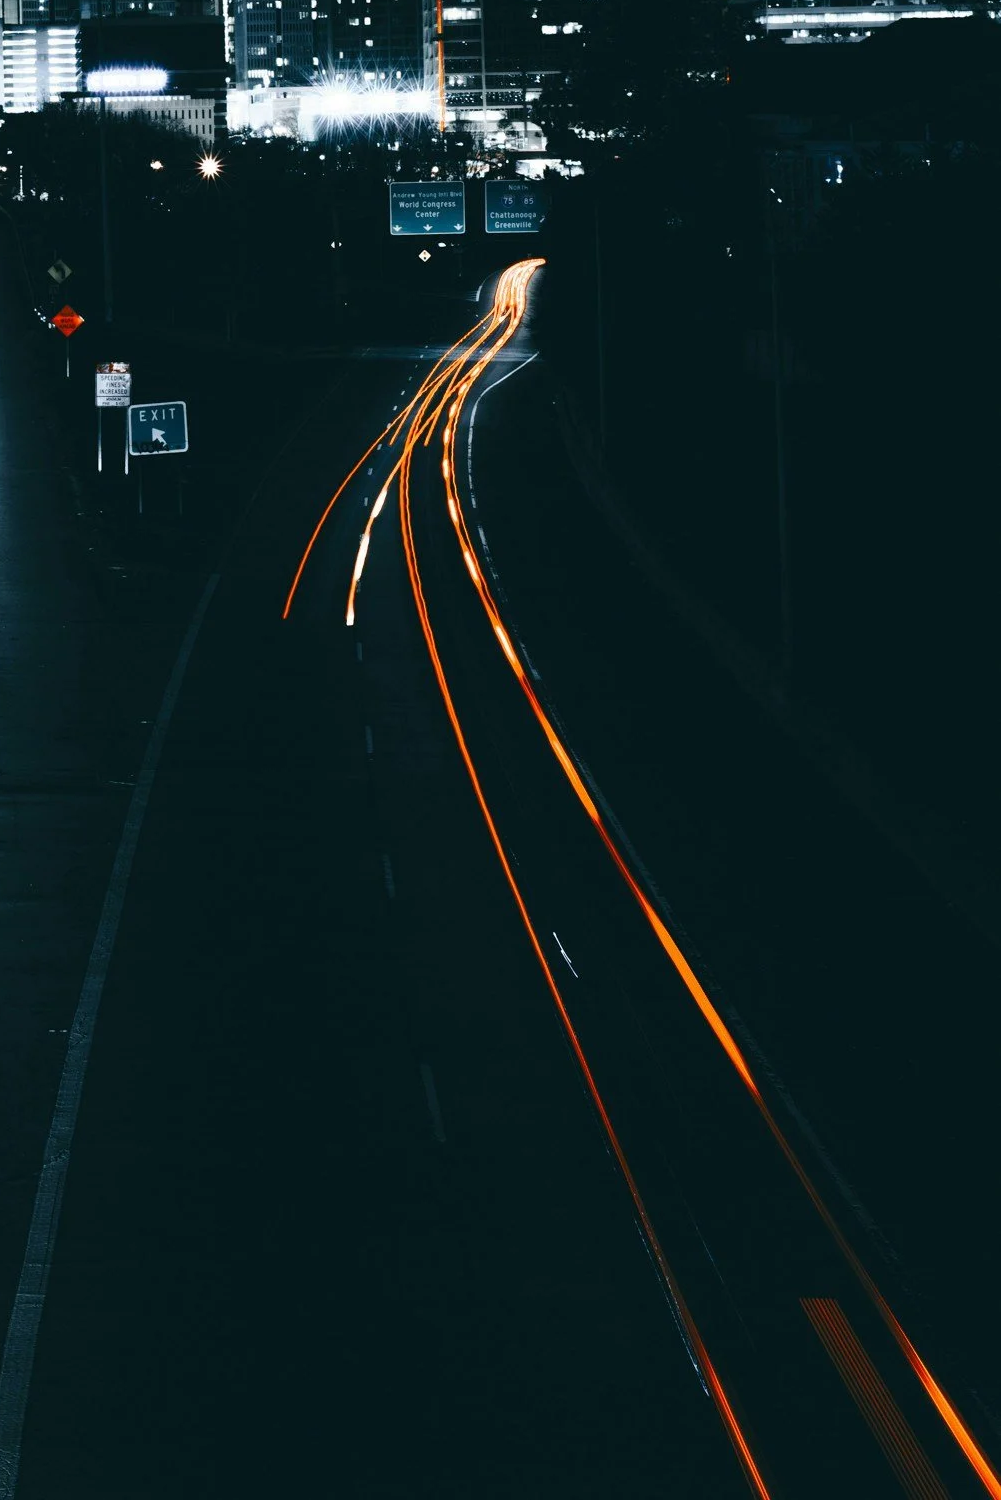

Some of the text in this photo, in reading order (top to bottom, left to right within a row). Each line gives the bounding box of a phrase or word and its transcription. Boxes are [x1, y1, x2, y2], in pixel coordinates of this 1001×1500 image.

[422, 201, 456, 209] Congress
[503, 197, 534, 205] 75 85
[490, 211, 537, 219] Chattanooga
[494, 221, 532, 229] Greenville
[139, 408, 176, 422] EXIT
